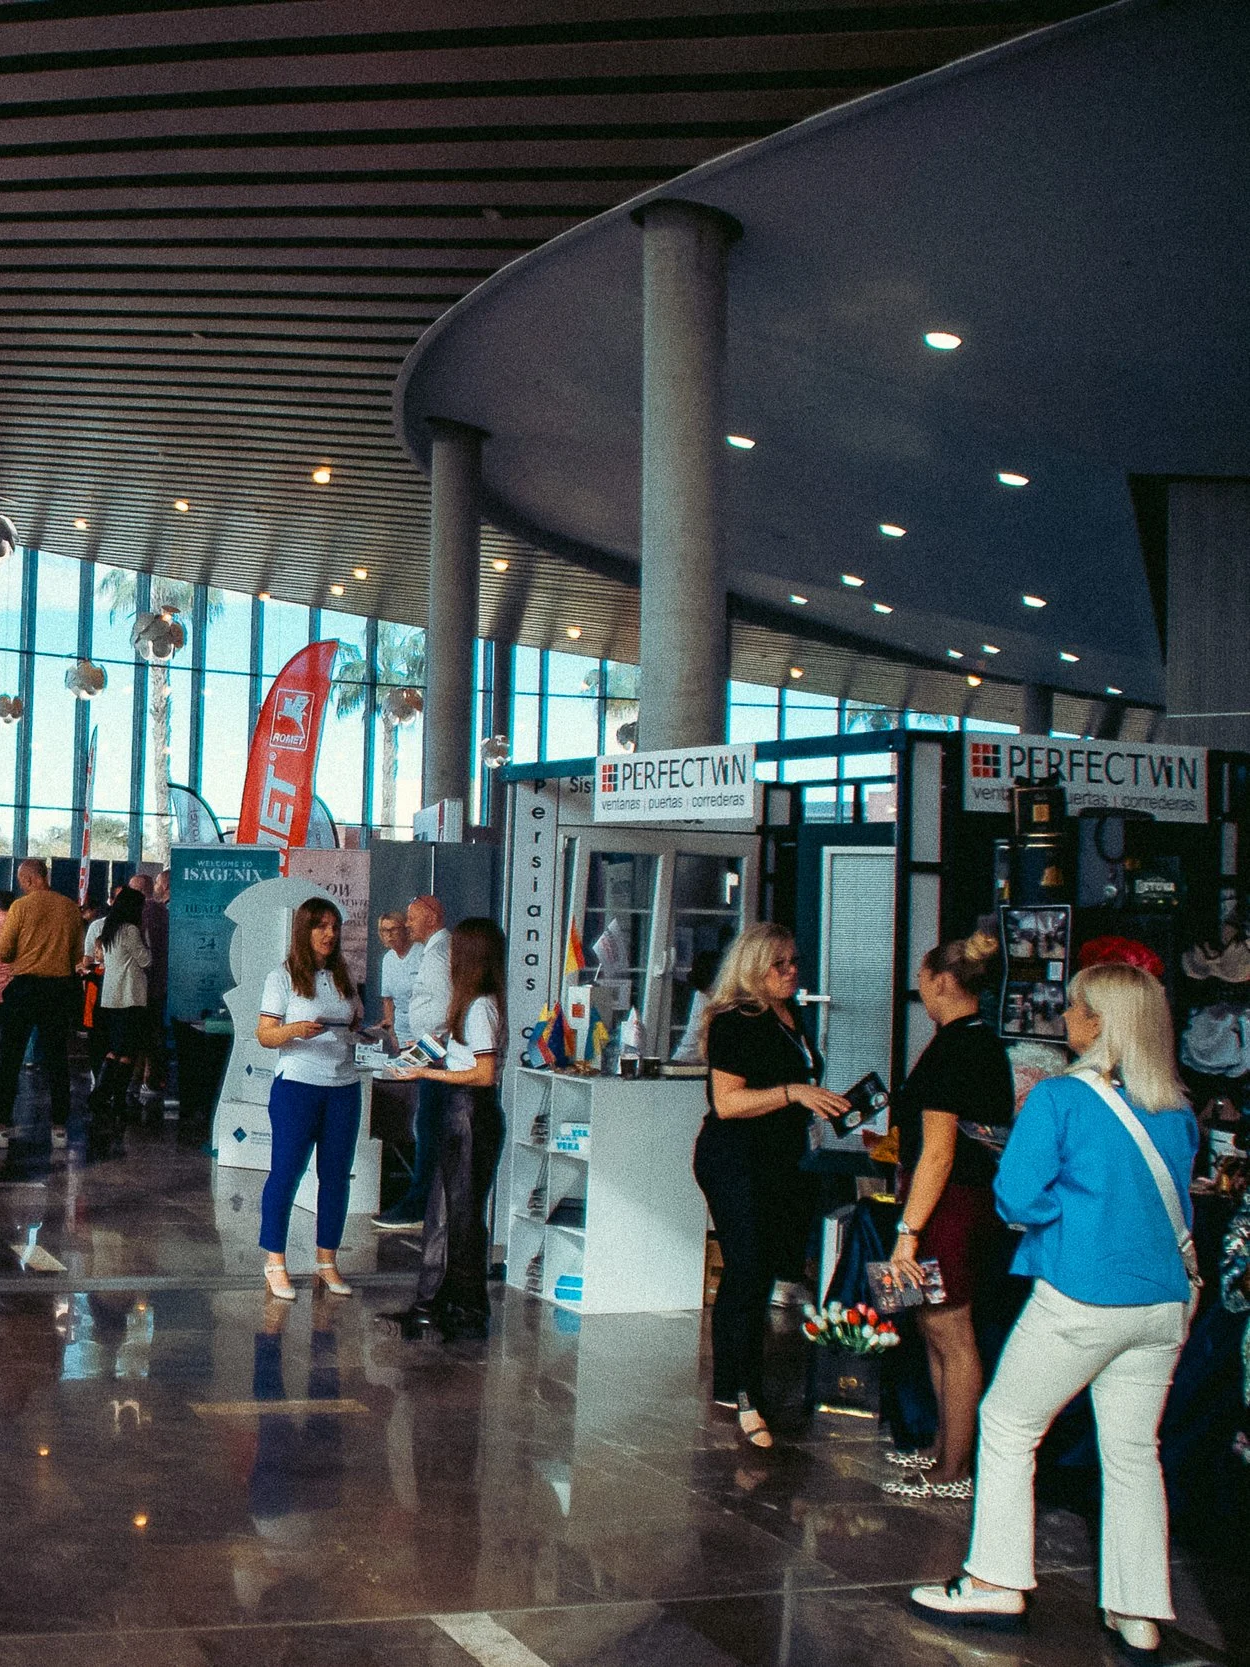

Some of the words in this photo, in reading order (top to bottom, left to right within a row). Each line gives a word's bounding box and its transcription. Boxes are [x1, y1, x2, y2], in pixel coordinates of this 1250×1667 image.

[273, 733, 305, 745] ROMET
[601, 798, 641, 812] ventanas
[648, 795, 683, 812] puertas
[692, 792, 745, 808] correderas
[1122, 794, 1197, 812] correderas
[197, 860, 239, 868] WELCOME
[242, 860, 253, 868] TO
[183, 867, 263, 882] ISAGENIX
[525, 779, 546, 991] Persianas
